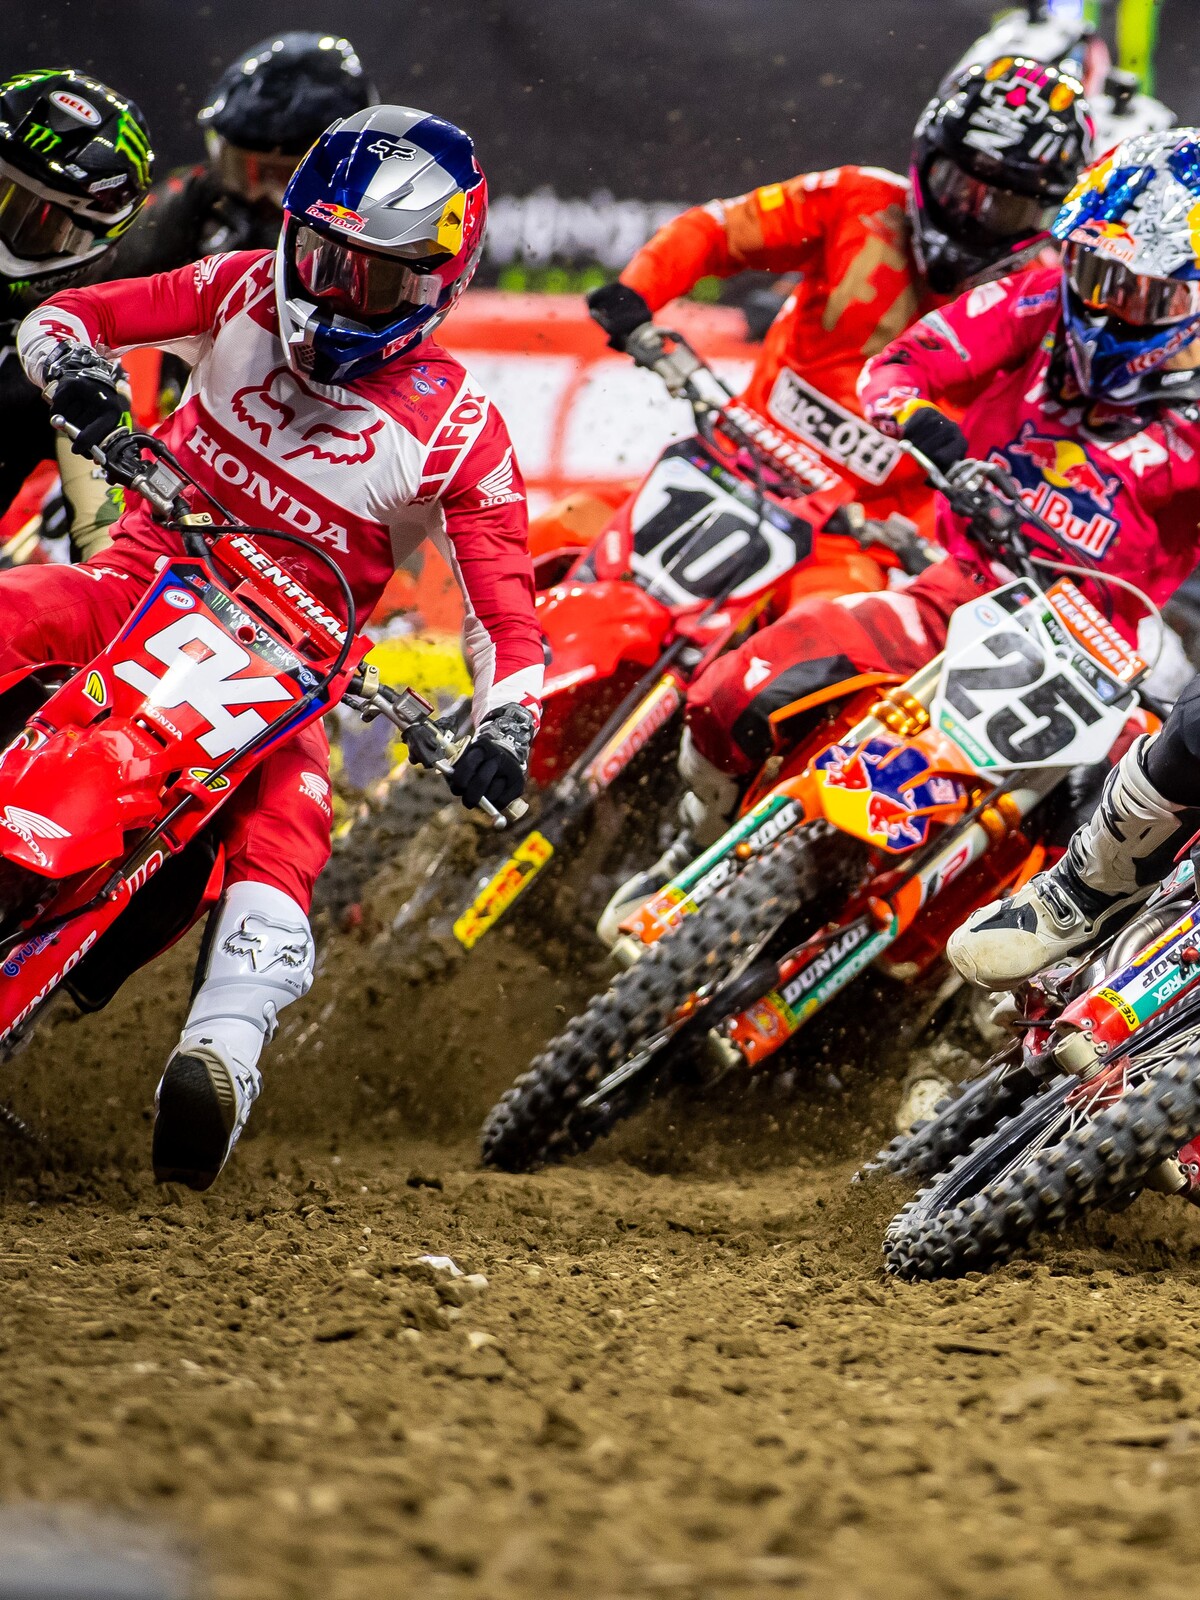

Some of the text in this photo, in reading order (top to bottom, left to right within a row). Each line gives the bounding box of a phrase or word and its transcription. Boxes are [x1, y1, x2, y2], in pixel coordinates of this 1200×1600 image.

[58, 95, 92, 119] BELL
[305, 206, 365, 233] Red Bull
[186, 424, 351, 554] HONDA
[1041, 489, 1119, 558] Bull
[633, 486, 771, 600] 10
[1050, 592, 1130, 673] RENTHAL
[112, 612, 295, 760] 94
[945, 631, 1104, 764] 25
[299, 784, 332, 817] HONDA
